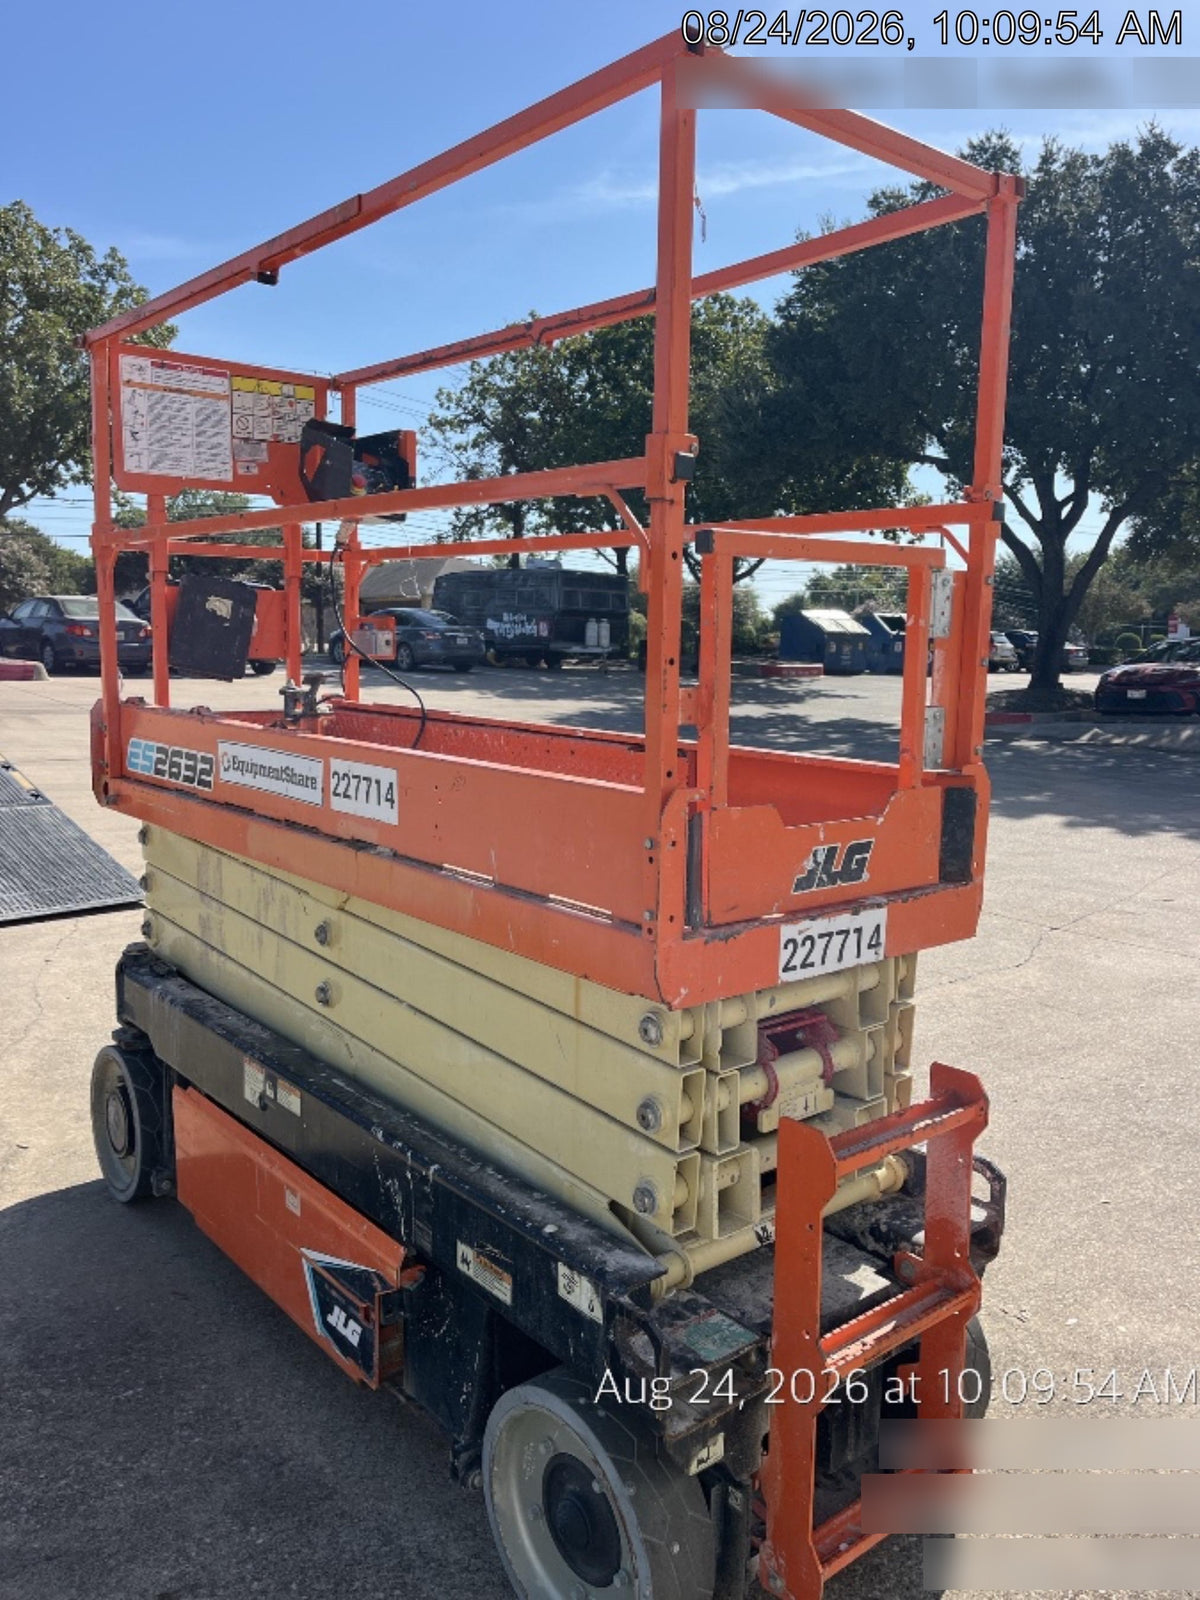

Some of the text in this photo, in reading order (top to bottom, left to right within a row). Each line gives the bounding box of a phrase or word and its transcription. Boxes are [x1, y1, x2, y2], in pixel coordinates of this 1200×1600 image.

[127, 739, 215, 790] ES2632
[231, 757, 318, 792] EquipmentShare
[331, 770, 396, 810] 227714
[792, 838, 875, 894] JLG
[781, 923, 882, 973] 227714
[326, 1304, 363, 1348] JLG
